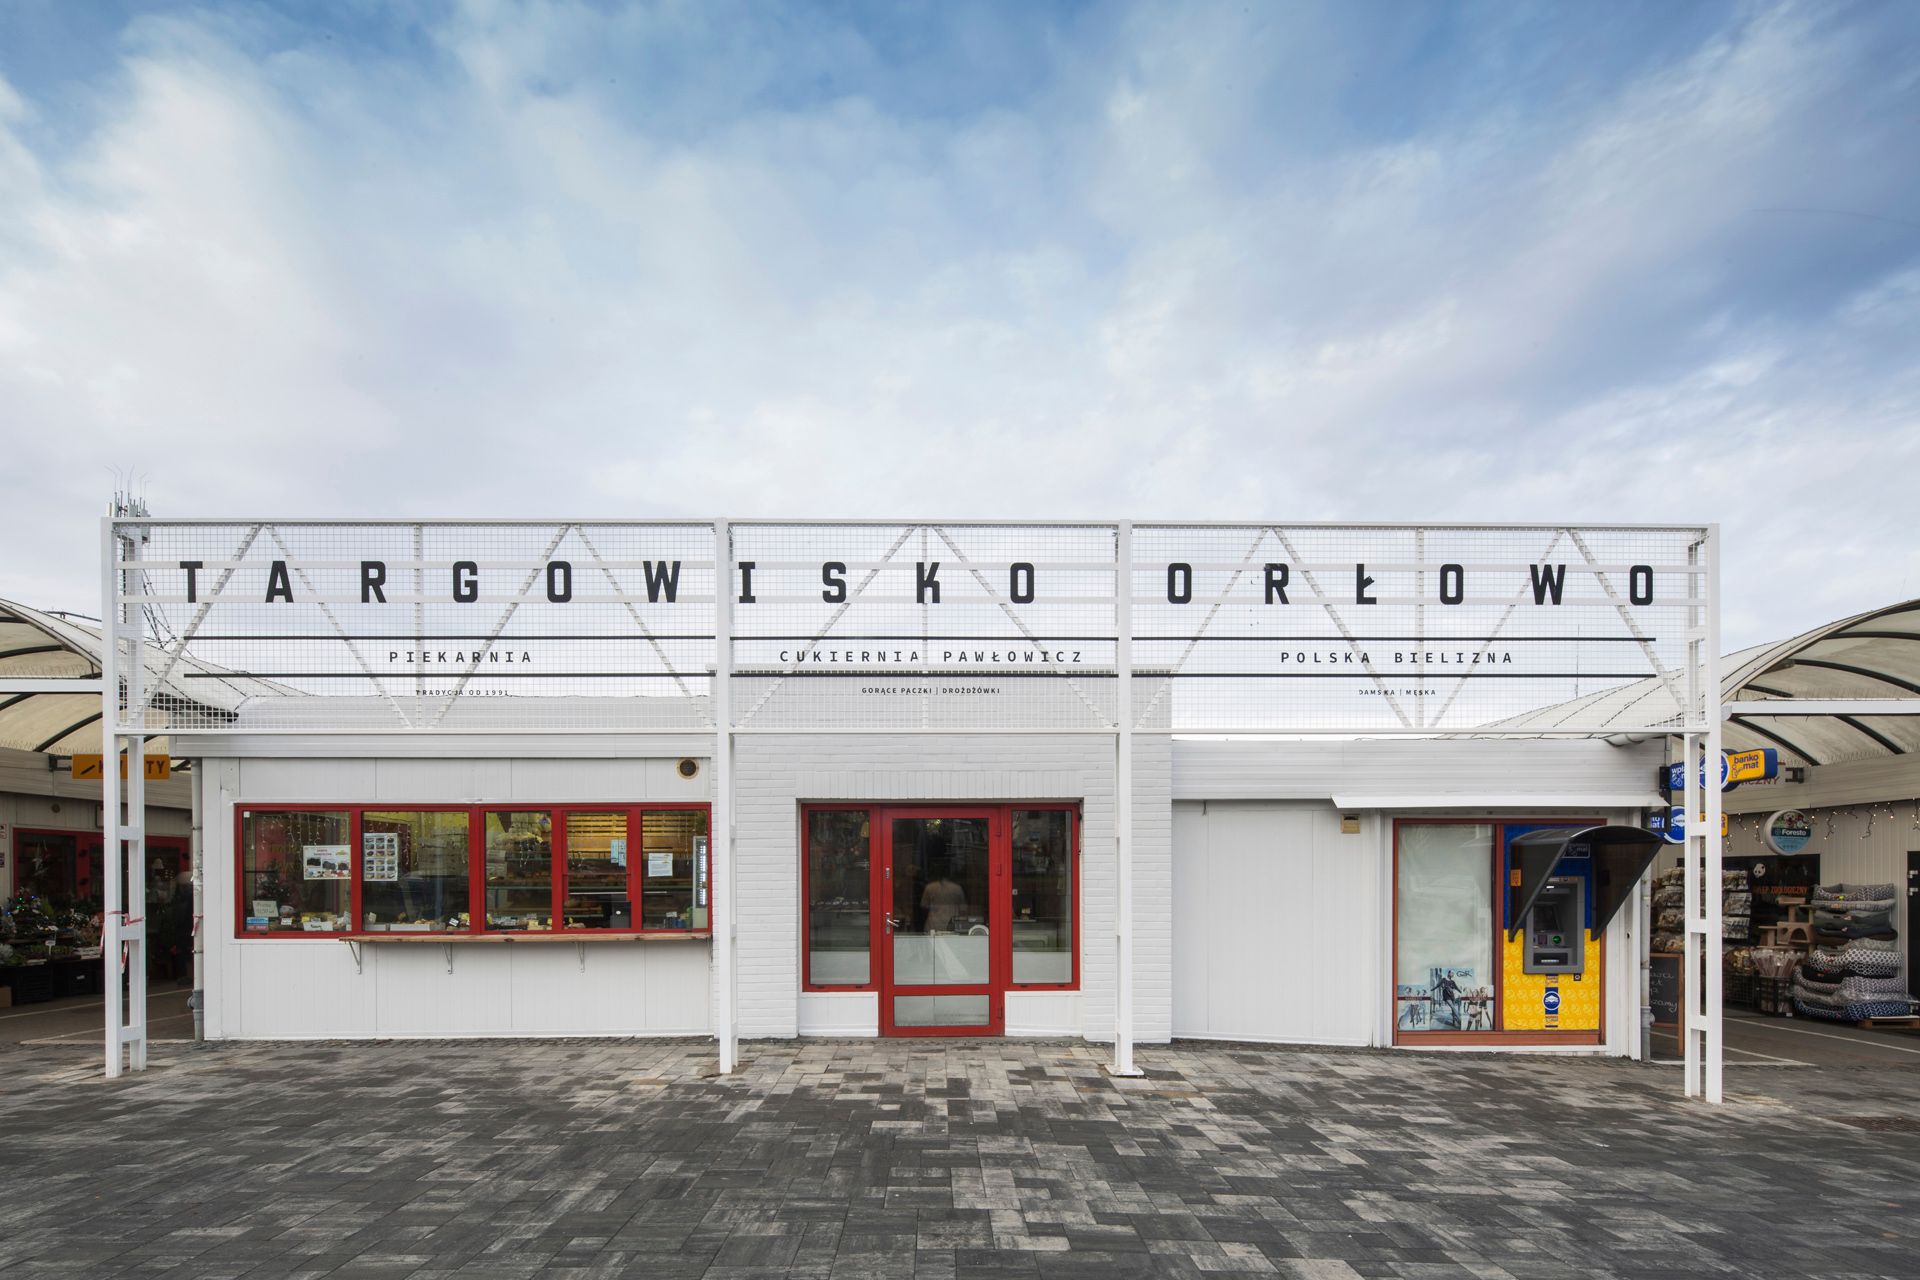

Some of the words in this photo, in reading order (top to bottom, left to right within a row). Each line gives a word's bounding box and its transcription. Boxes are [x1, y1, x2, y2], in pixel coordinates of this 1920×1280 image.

[179, 561, 1035, 604] TARGOWISKO
[1167, 562, 1654, 607] ORŁOWO
[389, 651, 531, 663] PIEKARNIA
[780, 651, 919, 662] CUKIERNIA
[943, 651, 1081, 662] PAWŁOWICZ
[1281, 652, 1370, 664] POLSKA
[1394, 652, 1512, 664] BIELIZNA
[861, 687, 897, 695] GORĄCE
[1734, 753, 1759, 764] banko
[1781, 828, 1807, 837] Foresto
